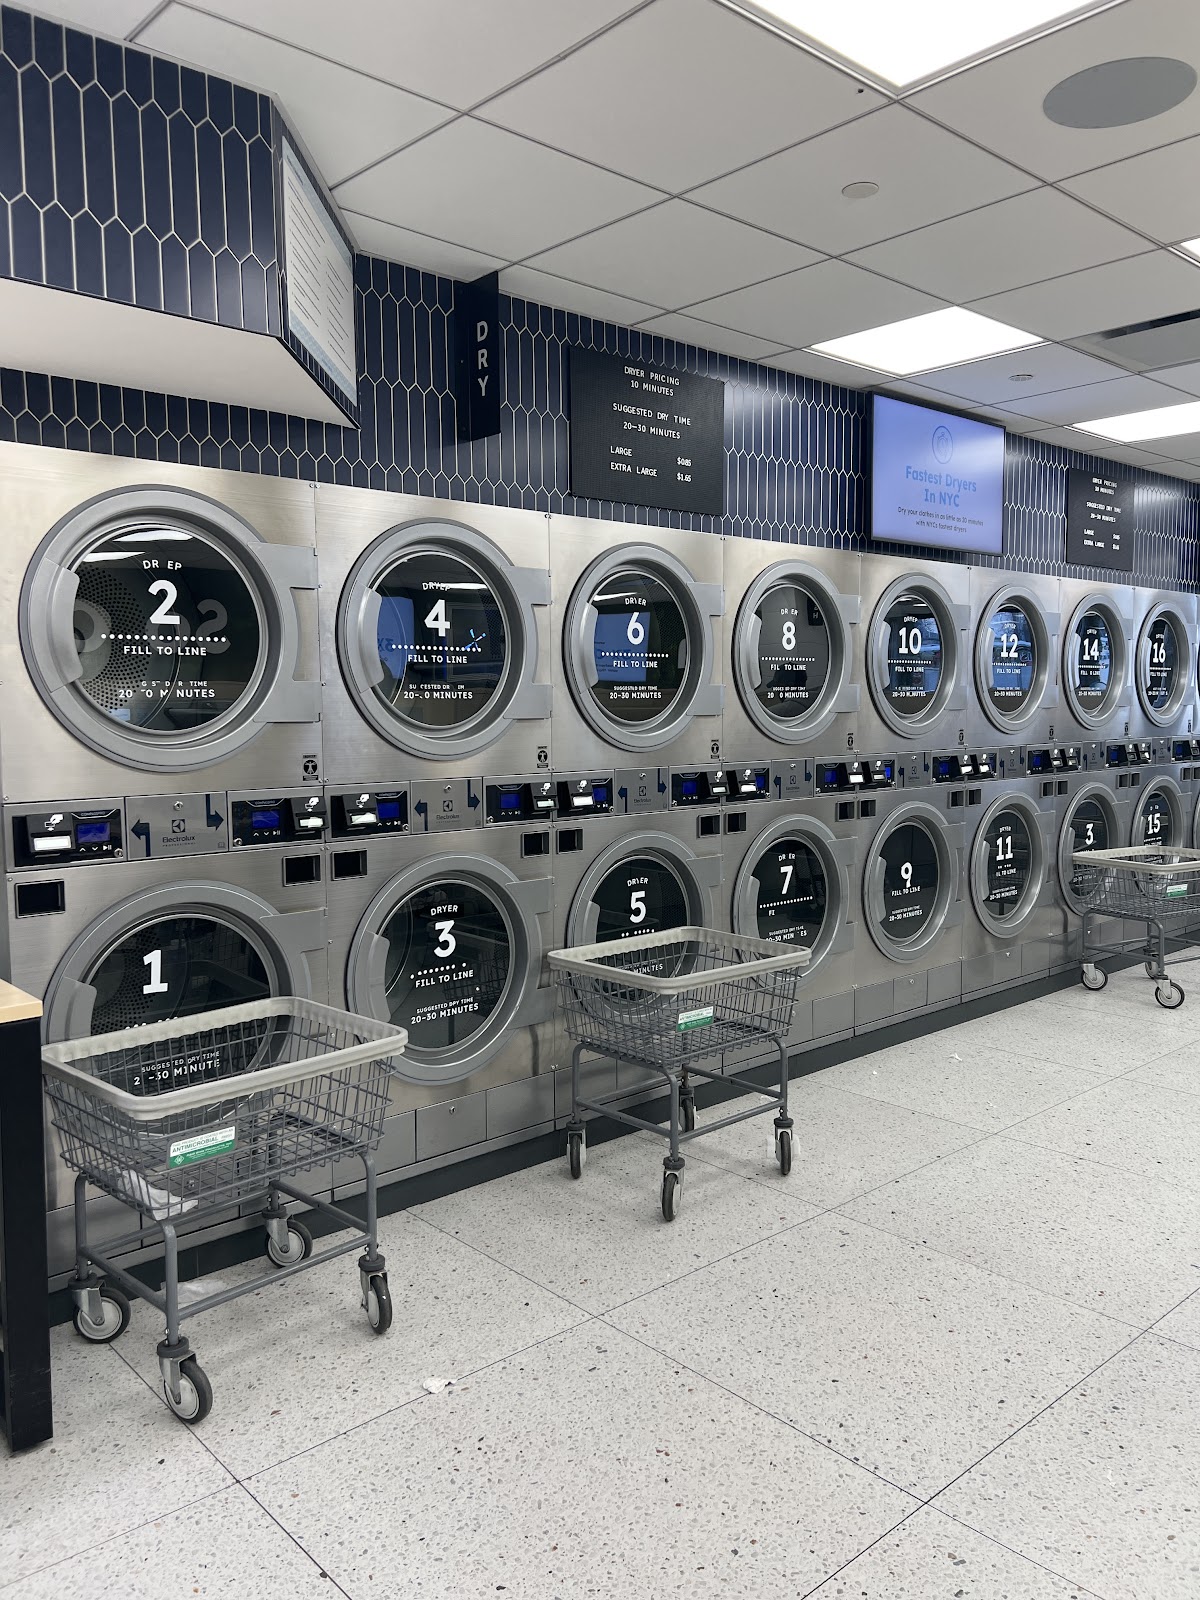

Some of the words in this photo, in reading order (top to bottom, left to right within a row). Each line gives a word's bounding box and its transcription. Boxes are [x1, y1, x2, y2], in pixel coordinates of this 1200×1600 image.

[477, 320, 488, 396] DRY
[624, 366, 645, 378] DRYER
[650, 372, 680, 386] PRICING
[630, 380, 638, 389] 10
[643, 382, 674, 396] MINUTES
[612, 402, 653, 418] SUGGESTED
[657, 411, 669, 422] DRY
[674, 415, 692, 426] TIME
[623, 422, 646, 433] 20-30
[650, 426, 681, 440] MINUTES
[610, 446, 632, 456] LARGE
[610, 462, 632, 473] EXTRA
[636, 466, 658, 477] LARGE
[906, 465, 942, 485] Fastest
[946, 474, 977, 492] Dryers
[924, 488, 936, 503] In
[940, 492, 960, 508] NYC
[898, 506, 906, 515] Dry
[148, 580, 180, 624] 2
[424, 598, 450, 637] 4
[627, 612, 644, 645] 6
[782, 621, 796, 650] 8
[124, 646, 152, 655] FILL
[157, 646, 173, 655] TO
[178, 647, 207, 656] LINE
[899, 627, 921, 654] 10
[1000, 634, 1018, 658] 12
[1083, 638, 1099, 660] 14
[446, 655, 468, 664] LINE
[1153, 642, 1166, 663] 16
[160, 689, 215, 698] MNUTES
[1147, 813, 1160, 835] 15
[996, 836, 1013, 861] 11
[780, 865, 793, 894] 7
[901, 862, 912, 888] 9
[430, 904, 458, 916] DRYER
[630, 890, 646, 923] 5
[903, 910, 922, 918] MINUTES
[434, 920, 456, 958] 3
[143, 950, 168, 994] 1
[416, 978, 436, 988] FILL
[439, 975, 450, 983] TO
[453, 969, 474, 980] LINE
[411, 1012, 437, 1024] 20-30
[440, 1003, 479, 1018] MINUTES
[416, 1003, 448, 1014] SUGGESTED
[188, 1054, 200, 1064] DRY
[203, 1051, 220, 1060] TIME
[134, 1070, 169, 1086] 2-30
[172, 1137, 218, 1153] ANTIMICROBIAL
